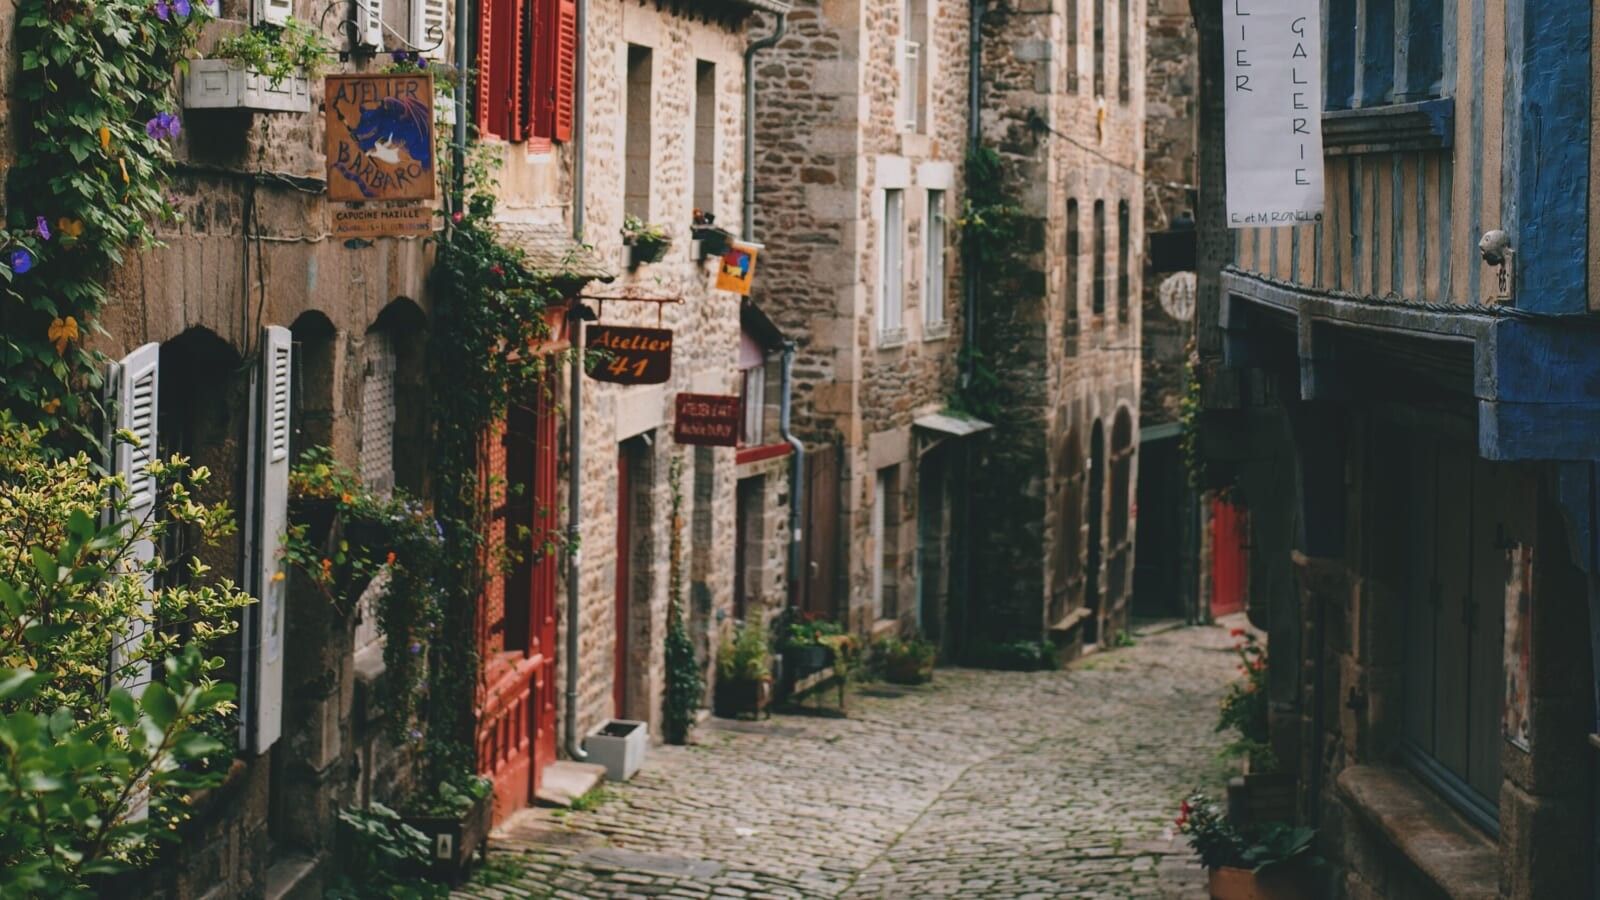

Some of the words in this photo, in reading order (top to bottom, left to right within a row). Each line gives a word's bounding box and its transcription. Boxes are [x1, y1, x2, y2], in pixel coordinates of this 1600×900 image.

[333, 80, 418, 107] ATELIER
[1291, 17, 1310, 186] GALERIE
[338, 141, 422, 190] BARBARO
[1231, 213, 1241, 223] E
[1258, 211, 1268, 224] M
[592, 331, 670, 352] Atelier
[608, 356, 648, 377] 41
